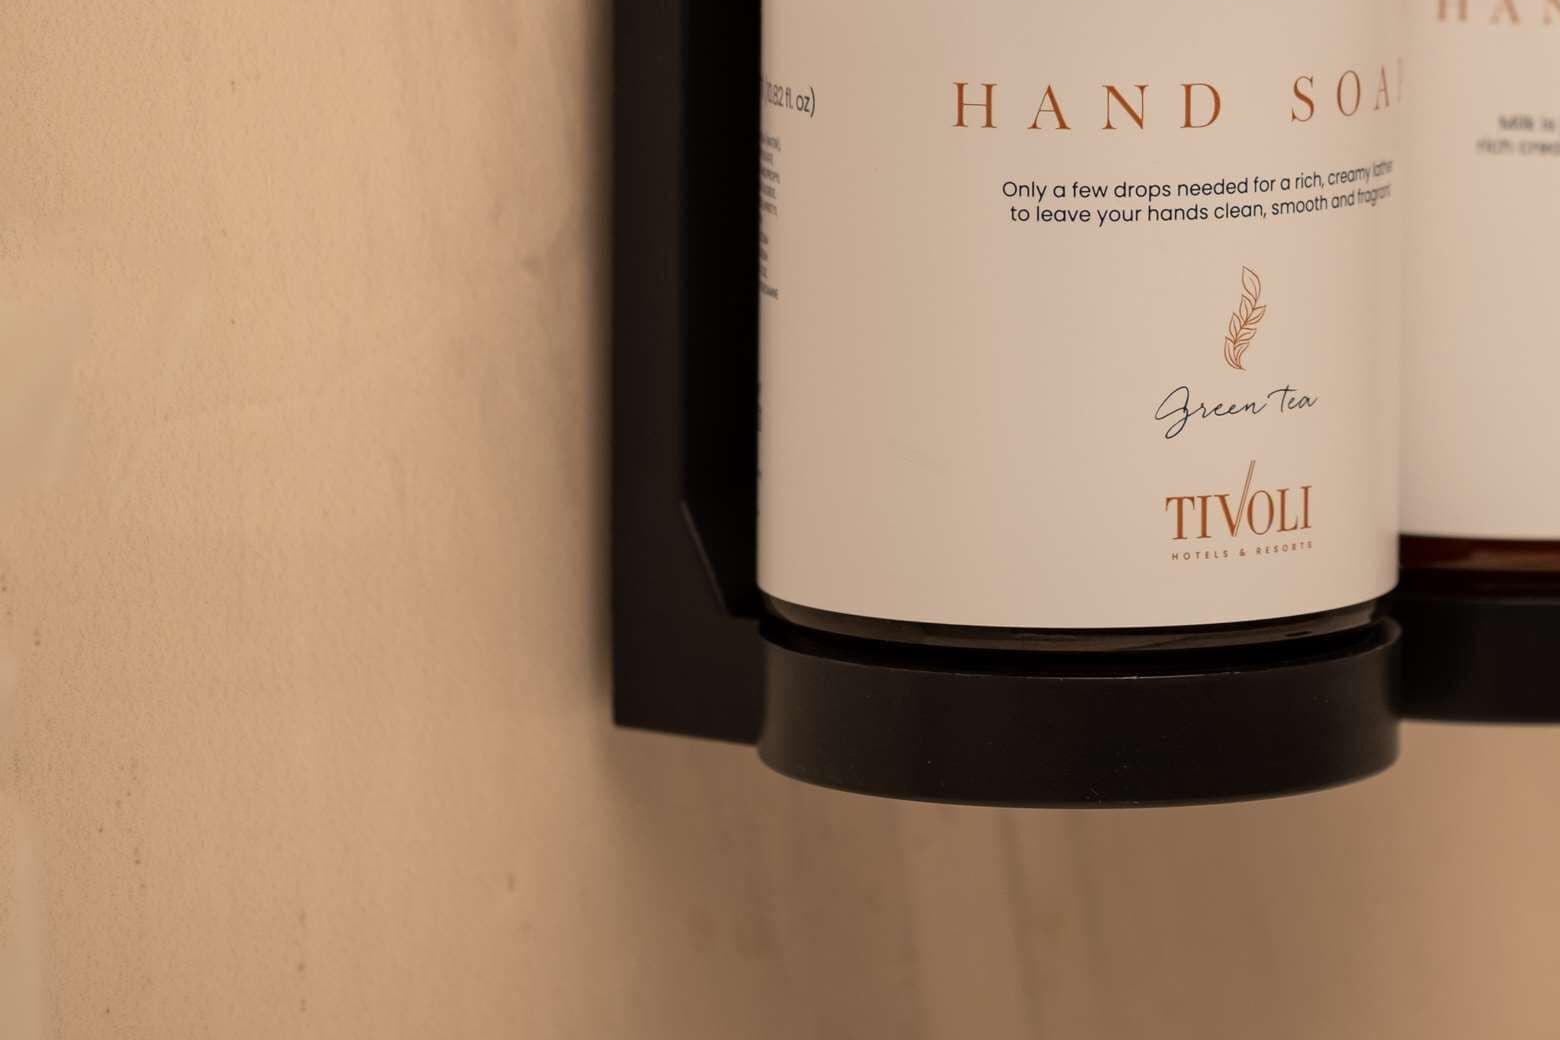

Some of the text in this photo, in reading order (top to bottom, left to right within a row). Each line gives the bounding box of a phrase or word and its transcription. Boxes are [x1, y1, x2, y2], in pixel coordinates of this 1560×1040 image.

[796, 86, 816, 119] oz)
[952, 82, 1221, 130] HAND
[1002, 181, 1047, 203] Only
[1053, 184, 1066, 198] a
[1072, 181, 1109, 198] few
[1114, 181, 1171, 202] drops
[1177, 177, 1249, 197] needed
[1254, 176, 1276, 193] for
[1280, 176, 1291, 191] a
[1295, 171, 1325, 189] rich,
[1328, 166, 1370, 186] creamy
[1010, 206, 1030, 222] to
[1036, 205, 1091, 222] leave
[1096, 208, 1142, 228] your
[1148, 204, 1209, 222] hands
[1214, 203, 1267, 219] clean,
[1271, 194, 1328, 216] smooth
[1331, 190, 1355, 209] and
[1155, 384, 1318, 440] Green Tea
[1165, 459, 1313, 541] TIVOLI
[1171, 540, 1313, 561] HOTELS & RESORTS
